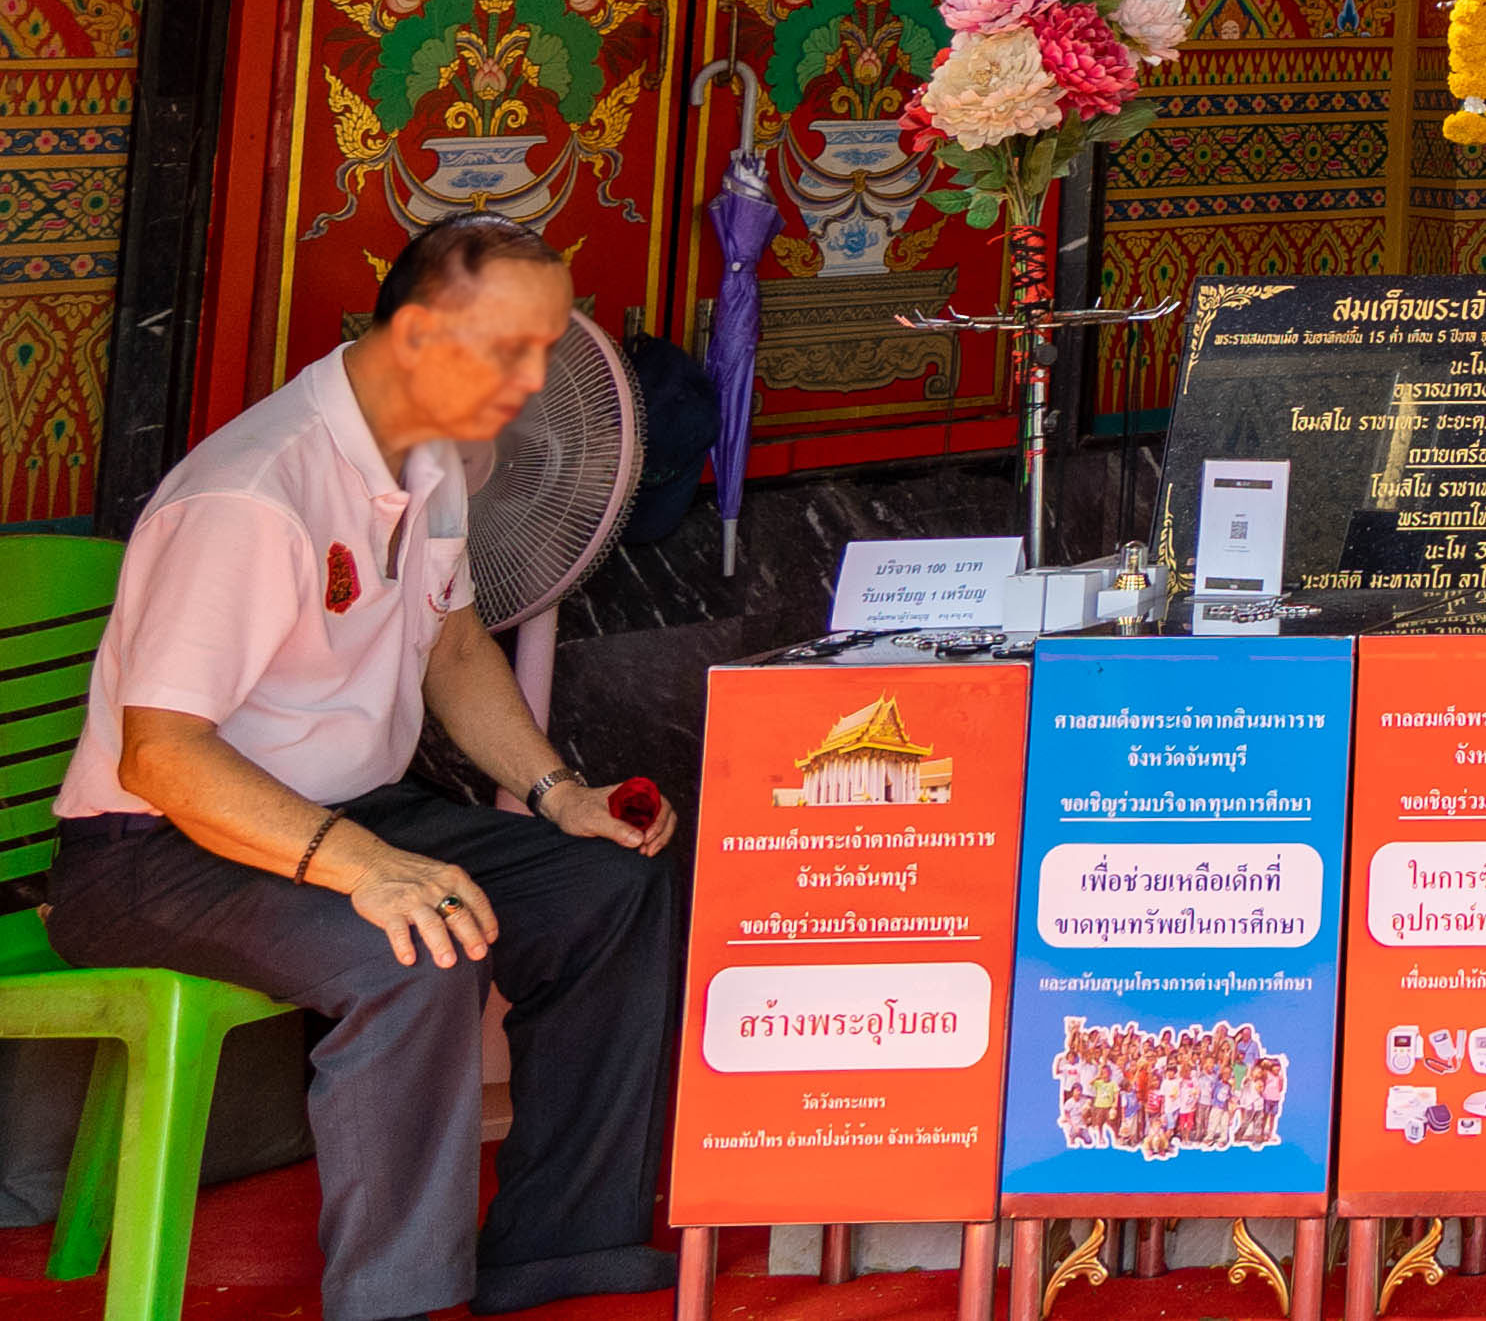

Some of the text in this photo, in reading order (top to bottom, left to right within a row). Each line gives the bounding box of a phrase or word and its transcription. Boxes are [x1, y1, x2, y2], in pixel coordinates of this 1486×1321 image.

[1369, 329, 1385, 344] 15
[1436, 328, 1447, 343] 5
[1291, 407, 1351, 432] โอมสิโน
[1371, 473, 1432, 498] โอมสิโน
[1424, 535, 1468, 560] นะโม
[875, 559, 984, 576] บริจาค 100 บาท
[861, 584, 987, 605] รับเหรียญ 1 เหรียญ
[1055, 705, 1326, 730] ศาลสมเด็จพระเจ้าตากสินมหาราช
[1127, 744, 1248, 772] จังหวัดจันทบุรี
[1060, 789, 1312, 817] ขอเชิญร่วมบริจาคทุนการศึกษา
[722, 825, 996, 852] ศาลสมเด็จพระเจ้าตากสินมหาราช
[796, 863, 918, 892] จังหวัดจันทบุรี
[1080, 853, 1282, 892] เพื่อช่วยเหลือเด็กที่
[740, 911, 969, 939] ขอเชิญร่วมบริจาคสมทบทุน
[1054, 908, 1306, 943] ขาดทุนทรัพย์ในการศึกษา
[1039, 970, 1313, 997] และสนับสนุนโครงการต่างๆในการศึกษา
[739, 998, 958, 1046] สร้างพระอุโบสถ
[801, 1092, 887, 1110] วัดวังกระแพร
[887, 1125, 979, 1148] จังหวัดจันทบุรี
